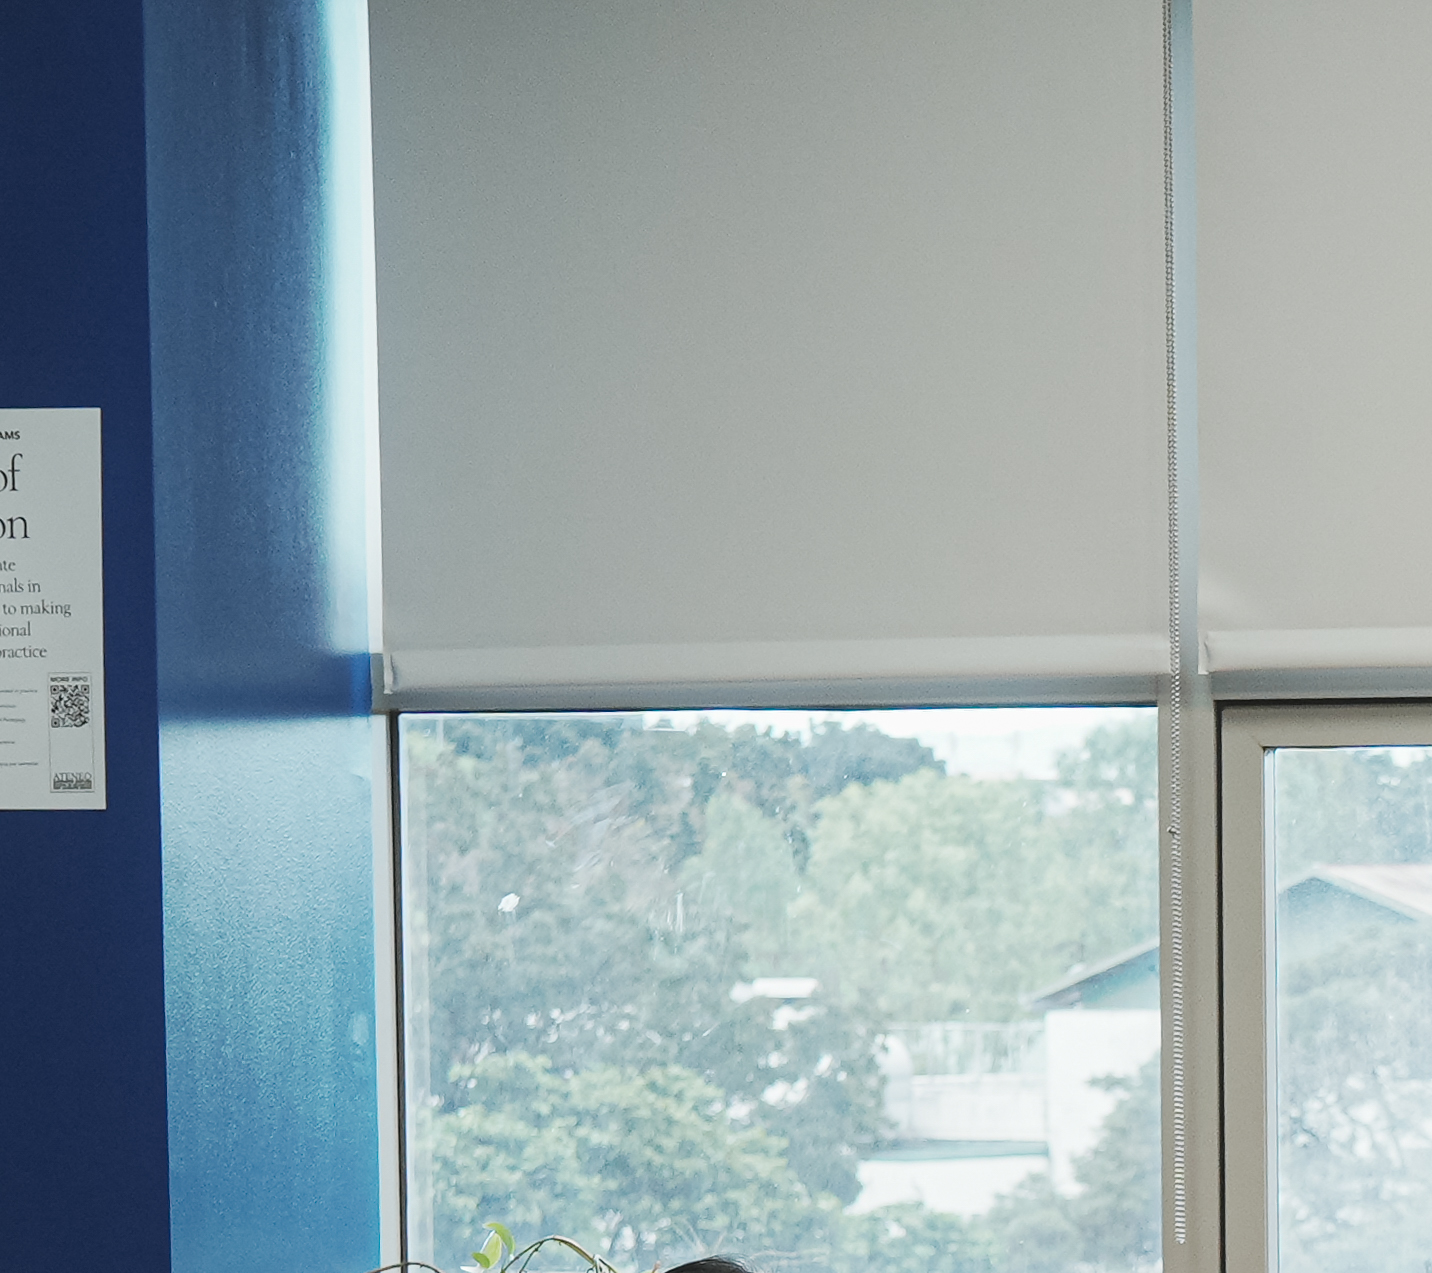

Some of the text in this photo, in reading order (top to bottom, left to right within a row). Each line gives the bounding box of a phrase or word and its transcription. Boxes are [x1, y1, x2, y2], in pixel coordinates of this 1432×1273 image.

[27, 579, 42, 593] in
[2, 603, 17, 616] to
[20, 599, 72, 617] making
